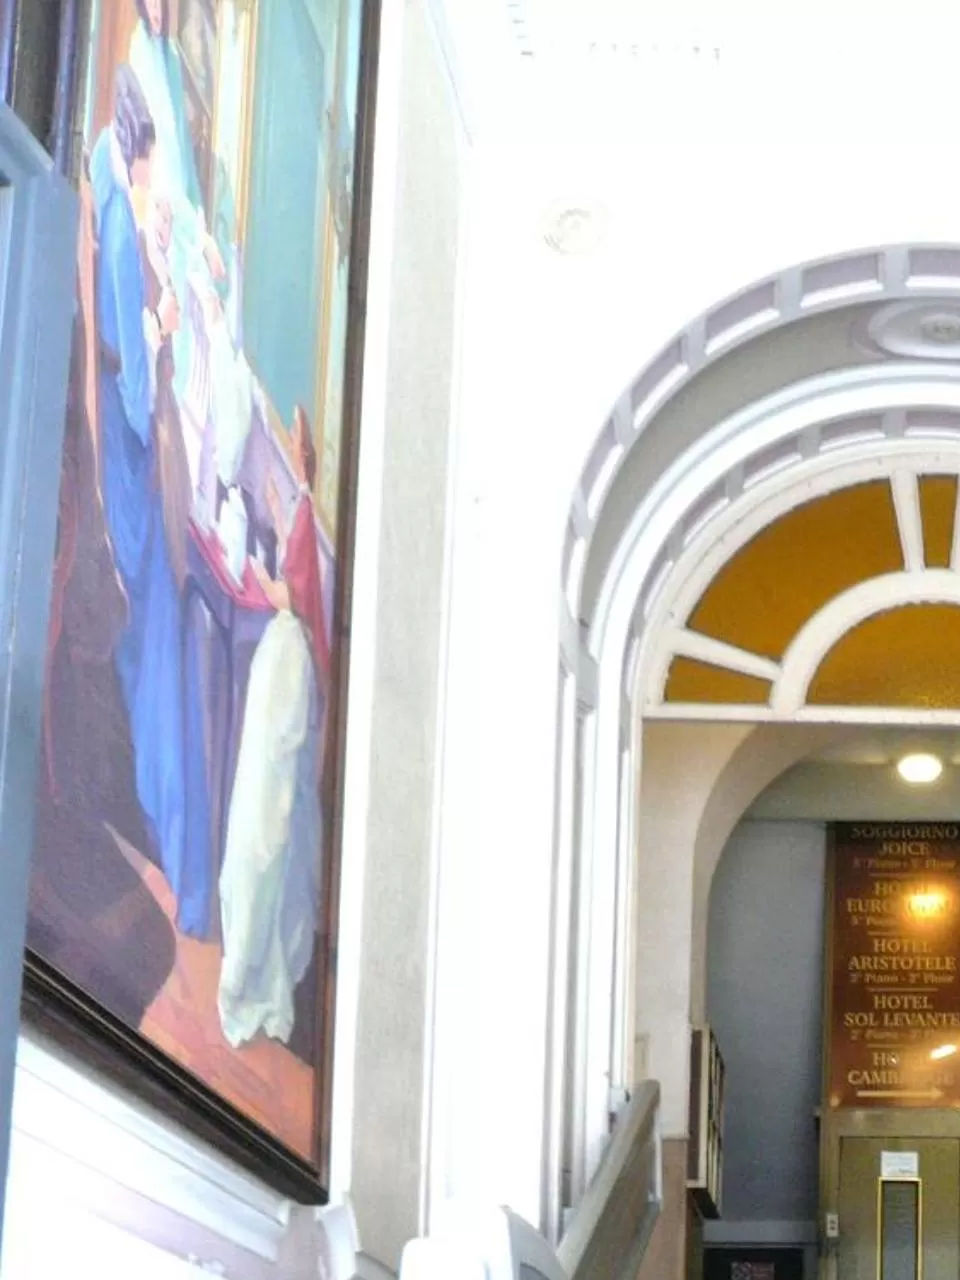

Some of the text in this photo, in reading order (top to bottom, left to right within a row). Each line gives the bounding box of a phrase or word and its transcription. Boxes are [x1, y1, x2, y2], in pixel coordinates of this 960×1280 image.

[850, 825, 959, 840] SOGGIORNO
[873, 938, 932, 953] HOTEL
[848, 955, 957, 971] ARISTOTELE
[873, 995, 933, 1010] HOTEL
[844, 1011, 960, 1028] SOL LEVANTE
